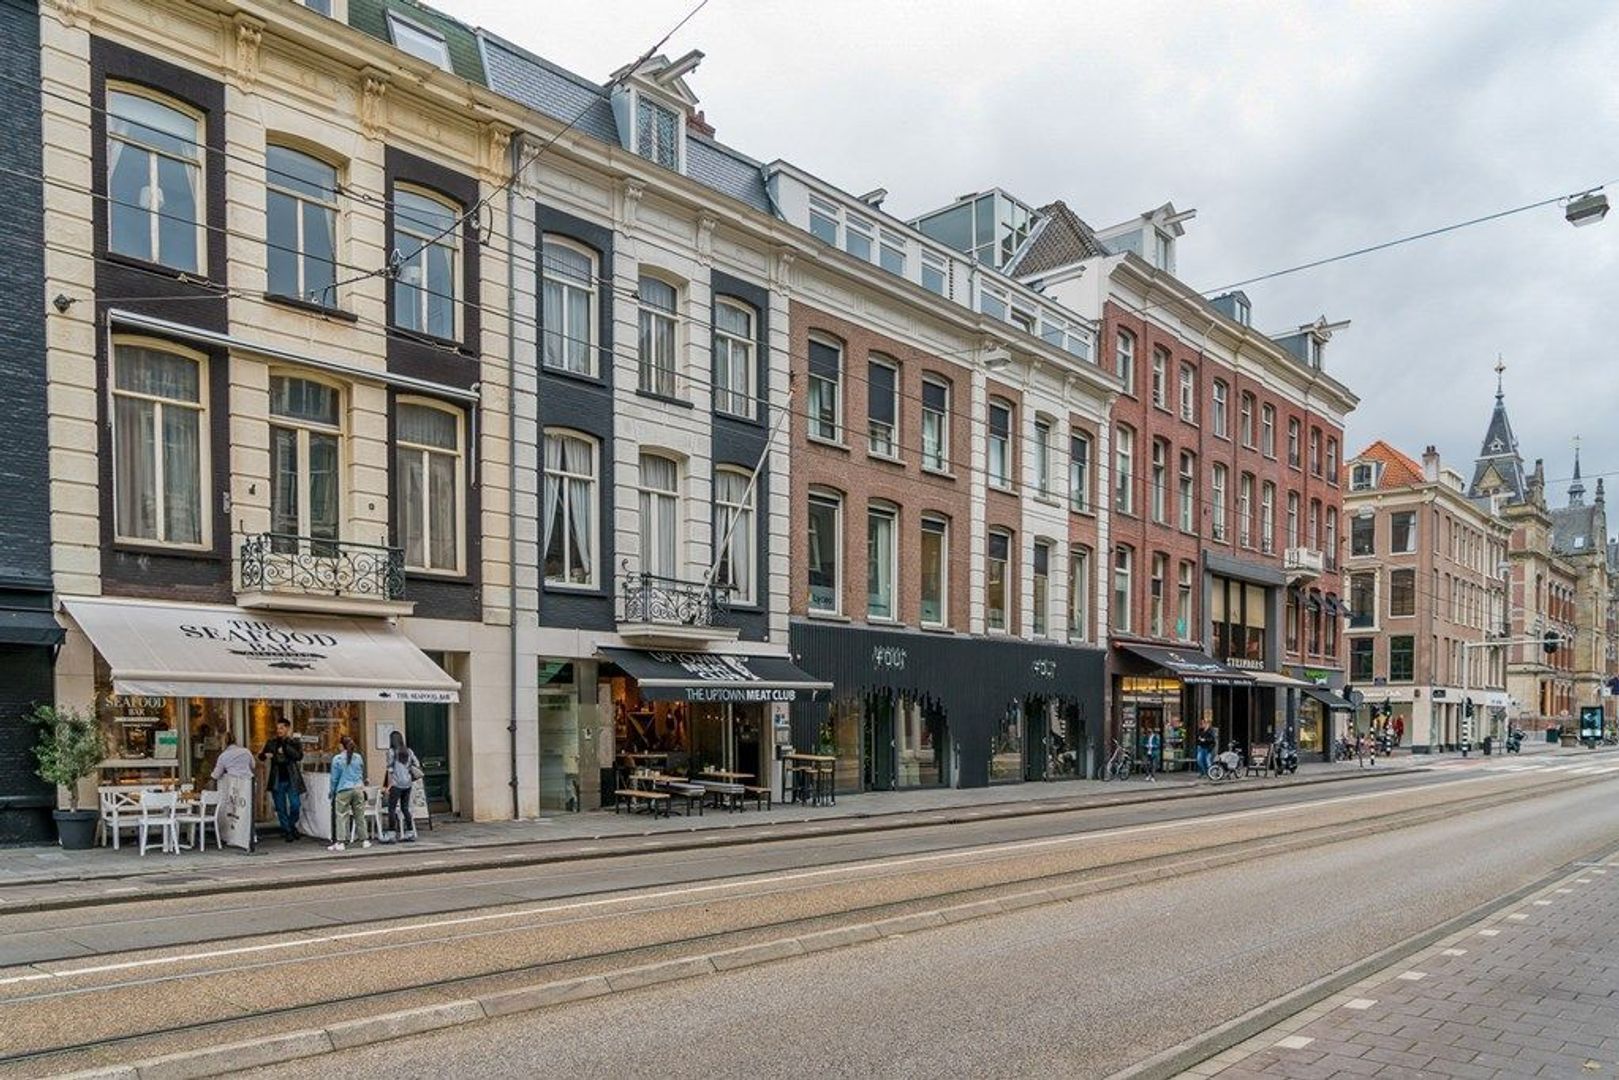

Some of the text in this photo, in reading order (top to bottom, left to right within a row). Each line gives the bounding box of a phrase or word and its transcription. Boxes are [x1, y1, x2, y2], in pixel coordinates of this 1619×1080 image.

[227, 619, 274, 631] THE
[179, 624, 338, 647] SEAFOOD
[248, 642, 296, 652] BAR
[649, 651, 722, 664] UPTOWN
[685, 688, 796, 701] THE UPTOWN MEAT CLUB
[105, 695, 166, 708] SEAFOOD
